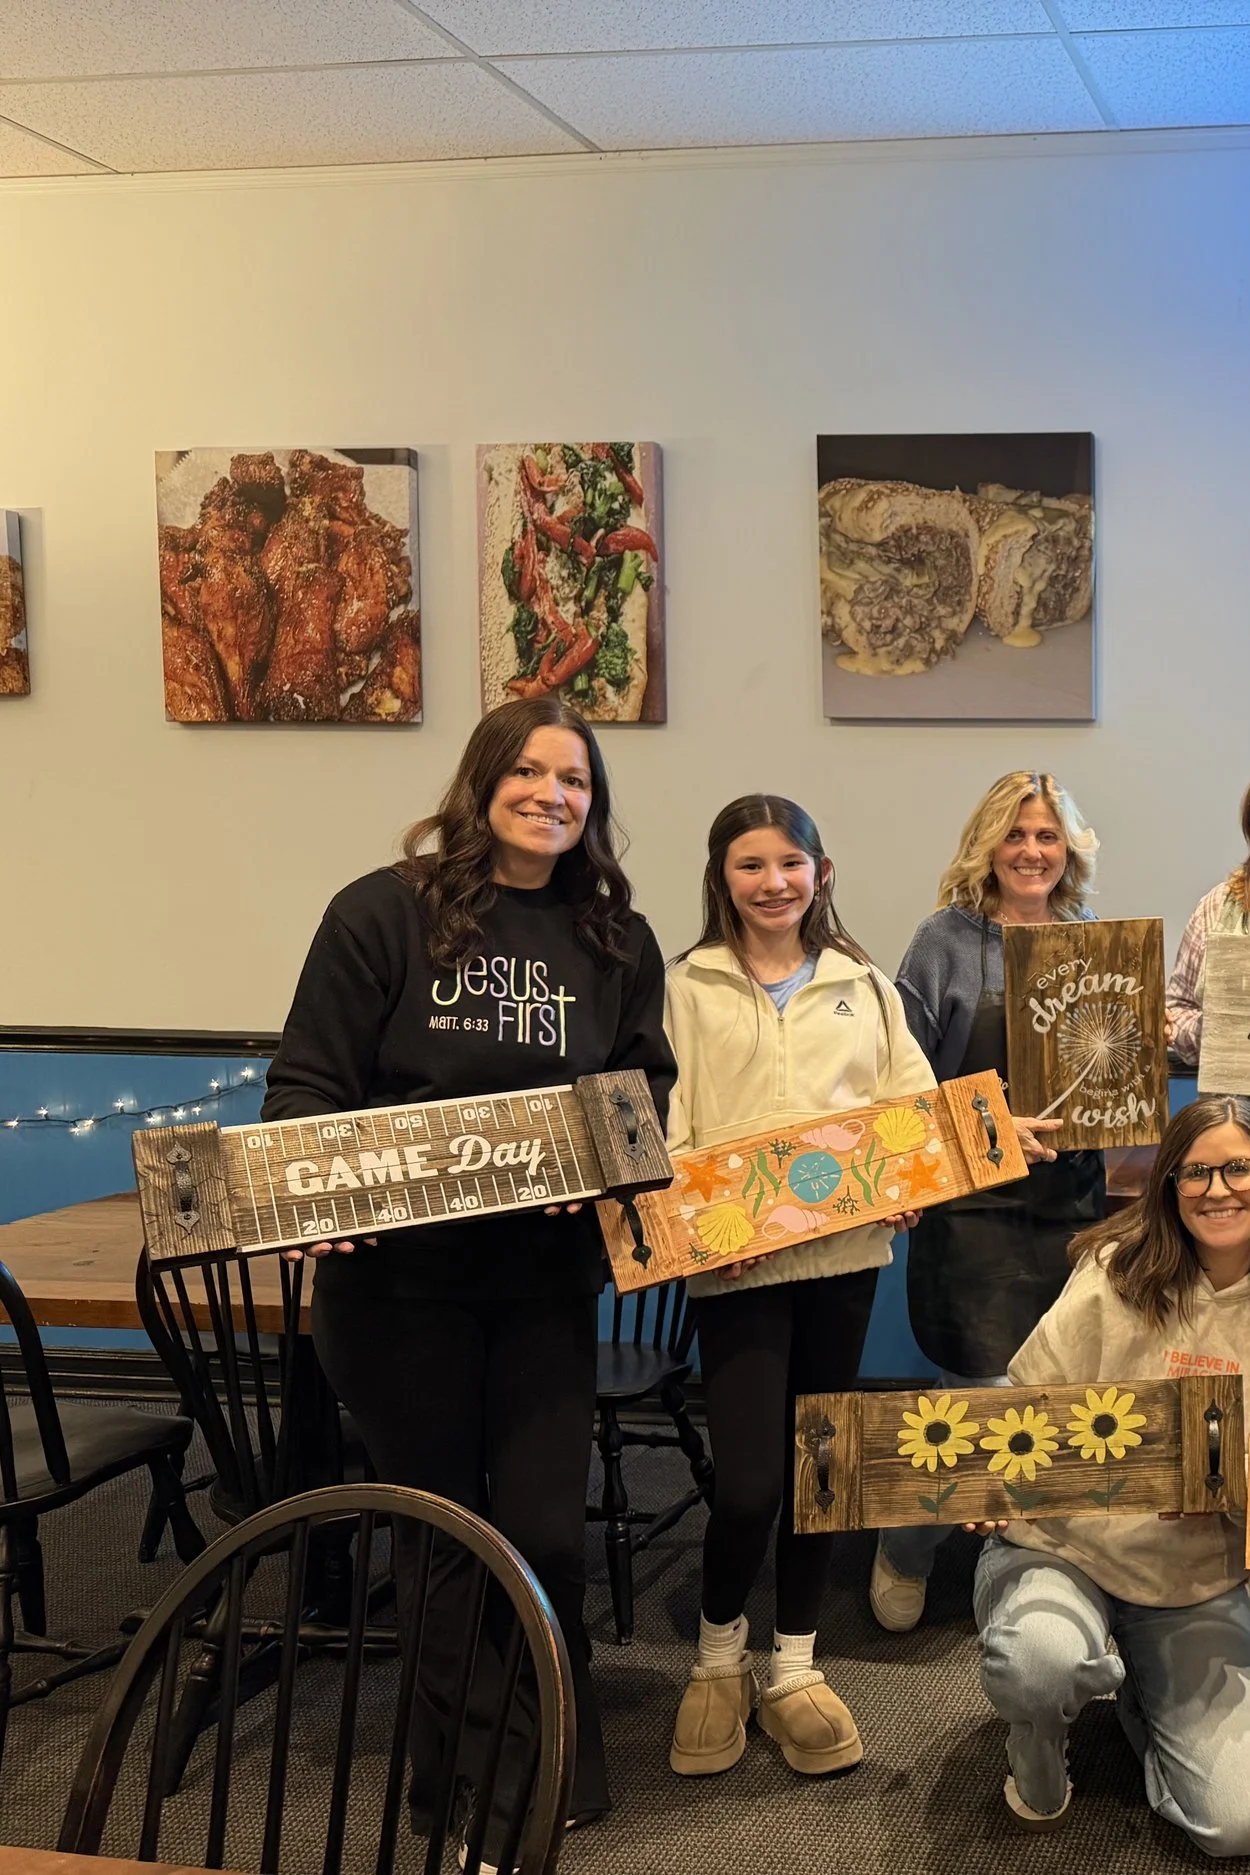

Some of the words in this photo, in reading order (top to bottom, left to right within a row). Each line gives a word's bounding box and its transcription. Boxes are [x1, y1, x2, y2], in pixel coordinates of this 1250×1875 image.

[1036, 957, 1093, 990] every
[1029, 972, 1144, 1034] dream
[463, 1017, 489, 1032] 6:33
[1079, 1081, 1119, 1100] begins
[1120, 1073, 1145, 1093] with
[322, 1124, 353, 1139] 30
[394, 1115, 423, 1130] 50
[462, 1106, 492, 1121] 30
[1071, 1092, 1156, 1129] wish
[285, 1143, 439, 1196] GAME
[447, 1134, 546, 1176] Day
[302, 1218, 334, 1235] 20
[377, 1206, 408, 1223] 40
[450, 1195, 479, 1211] 40
[517, 1184, 548, 1201] 20
[1163, 1350, 1168, 1361] I
[1170, 1351, 1223, 1371] BELIEVE
[1225, 1360, 1240, 1374] IN
